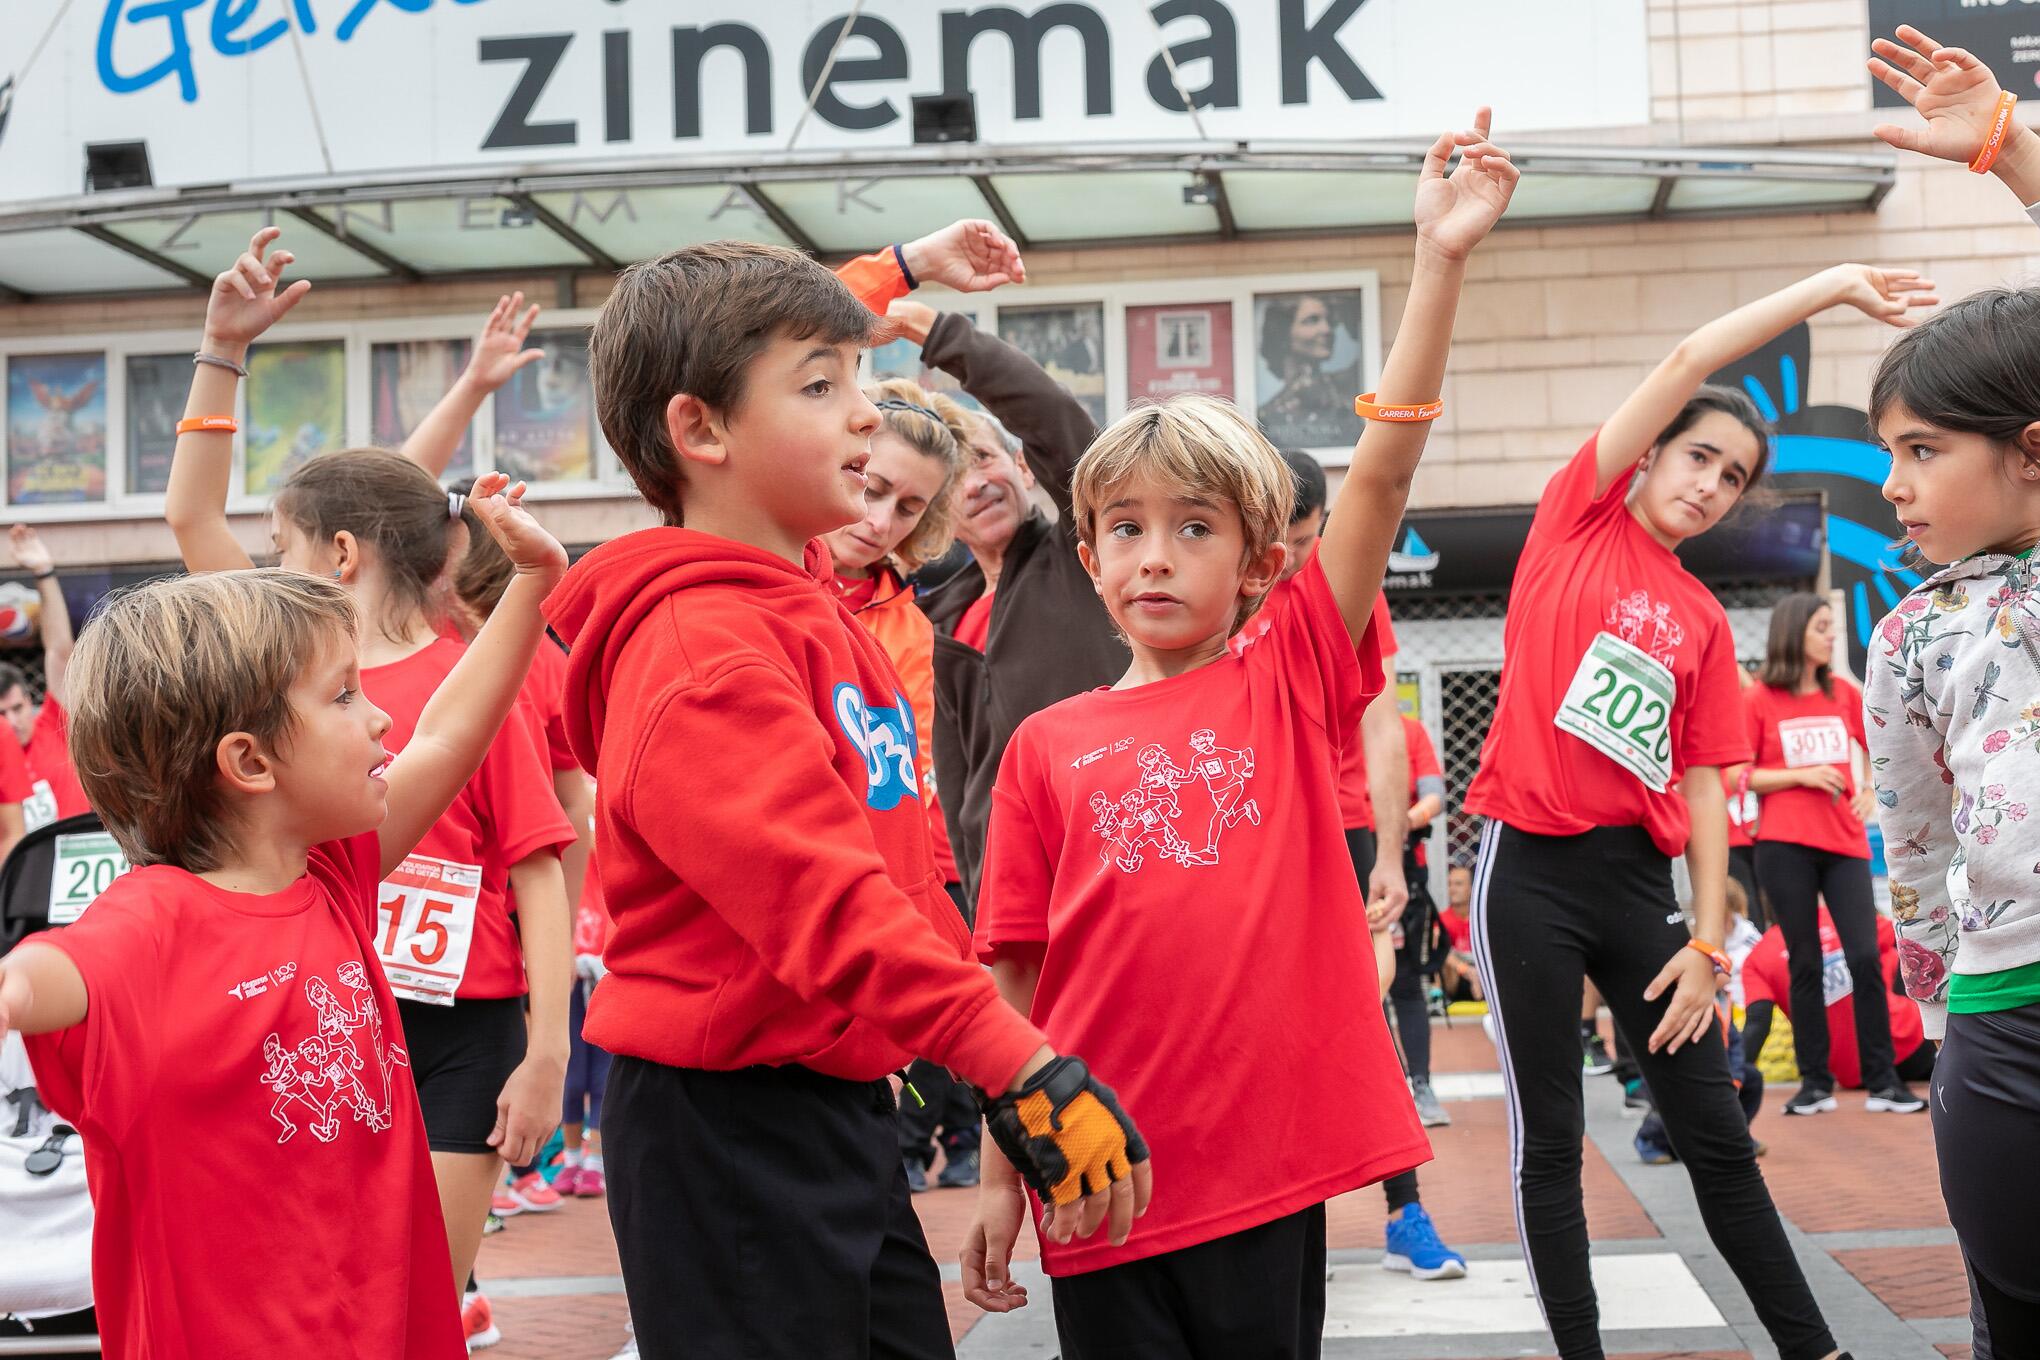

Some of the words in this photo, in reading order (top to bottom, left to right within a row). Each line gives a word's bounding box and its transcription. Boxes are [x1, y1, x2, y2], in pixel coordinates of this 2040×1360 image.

[479, 0, 1386, 150] zinemak
[1378, 408, 1416, 418] CARRERA
[1114, 737, 1134, 749] 100
[1790, 730, 1841, 754] 3013
[67, 858, 128, 898] 20
[379, 894, 454, 965] 15
[274, 961, 297, 977] 100
